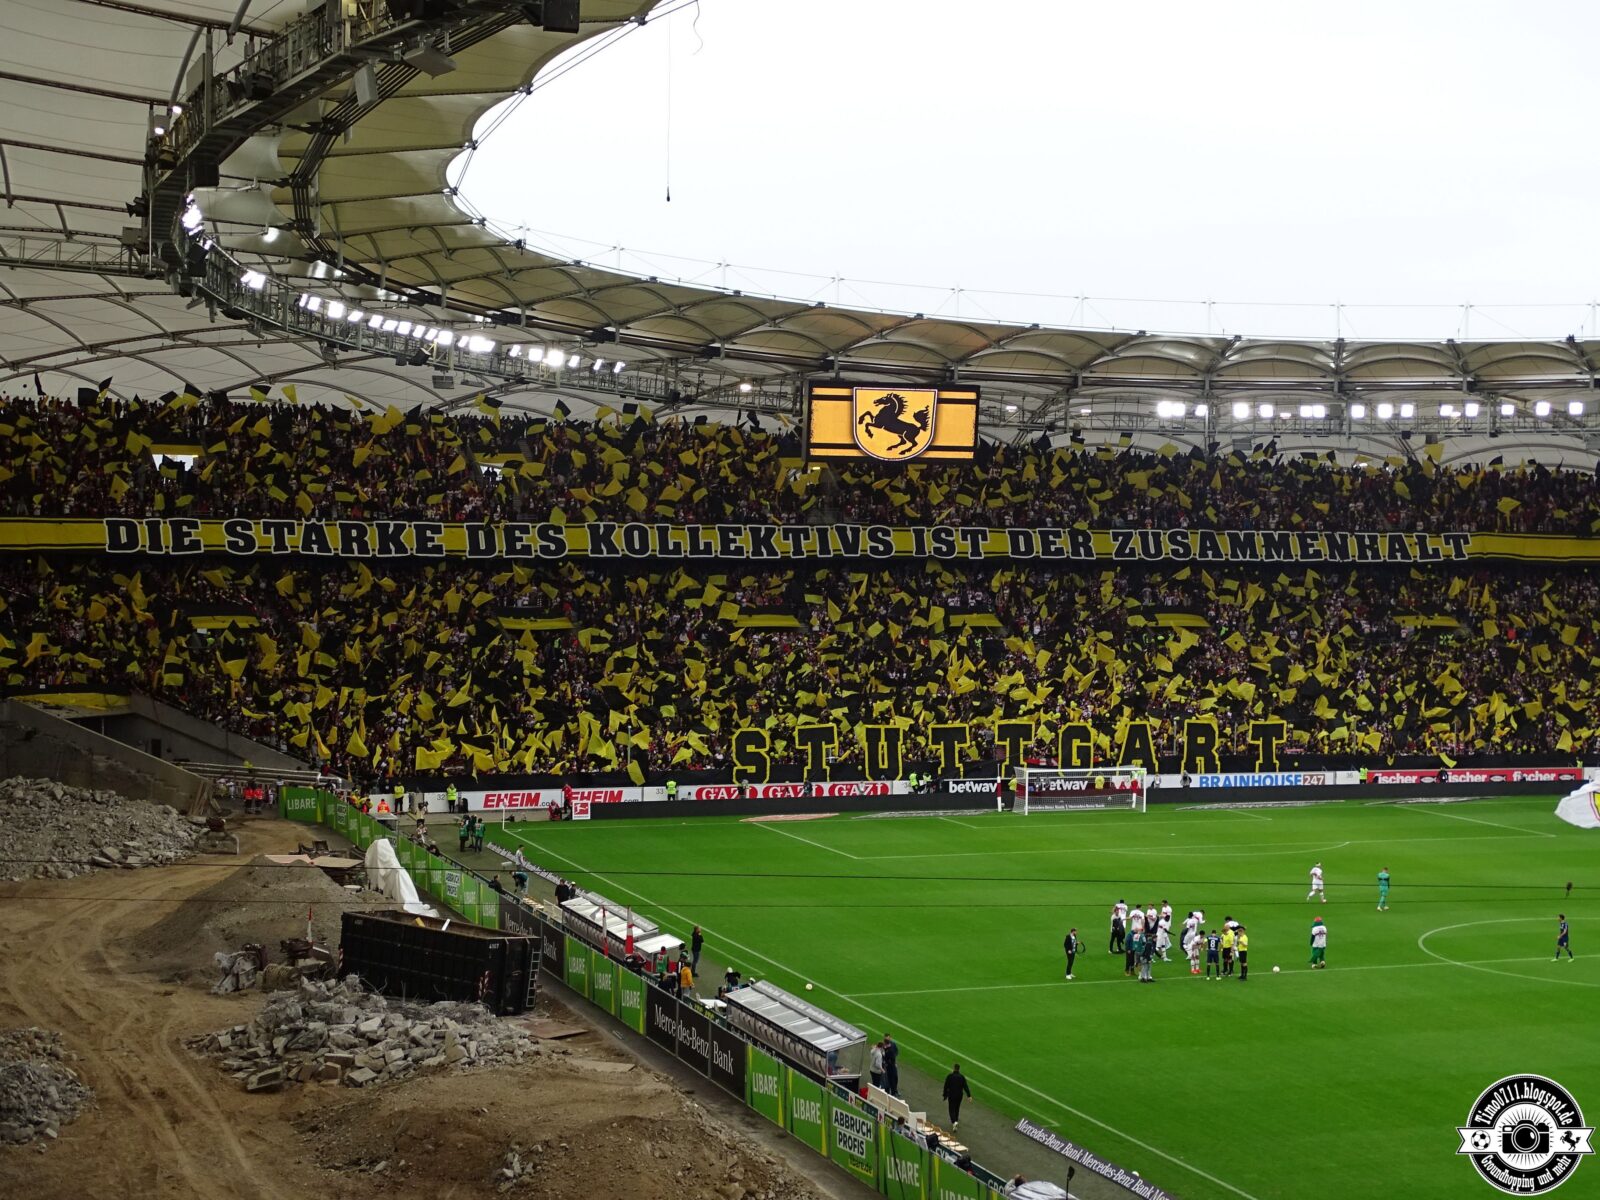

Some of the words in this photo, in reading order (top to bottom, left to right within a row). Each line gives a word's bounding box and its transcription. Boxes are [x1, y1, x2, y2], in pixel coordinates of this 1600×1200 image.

[104, 518, 203, 554] DIE
[224, 515, 444, 557] STÄRKE
[464, 521, 568, 558] DES
[586, 522, 895, 558] KOLLEKTIVS
[911, 526, 989, 559] IST
[1007, 528, 1096, 560] DER
[1111, 528, 1470, 562] ZUSAMMENHALT
[731, 720, 1288, 785] STUTTGART
[834, 783, 882, 796] GAZI
[949, 780, 998, 793] betway
[1447, 772, 1488, 782] ischer
[287, 798, 316, 810] LIBARE
[1210, 940, 1215, 948] 8
[595, 973, 611, 991] LIBARE
[622, 989, 640, 1008] LIBARE
[654, 1004, 709, 1058] Mercedes-Benz
[713, 1041, 734, 1075] Bank
[753, 1072, 778, 1097] LIBARE
[793, 1097, 821, 1124] LIBARE
[834, 1110, 872, 1139] ABBRUCH
[838, 1131, 864, 1156] PROFIS
[887, 1155, 919, 1187] LIBARE
[1015, 1118, 1064, 1151] Mercedes-Benz
[1061, 1142, 1084, 1162] Bank
[1079, 1152, 1134, 1188] Mercedes-Benz
[1131, 1178, 1155, 1200] Bank
